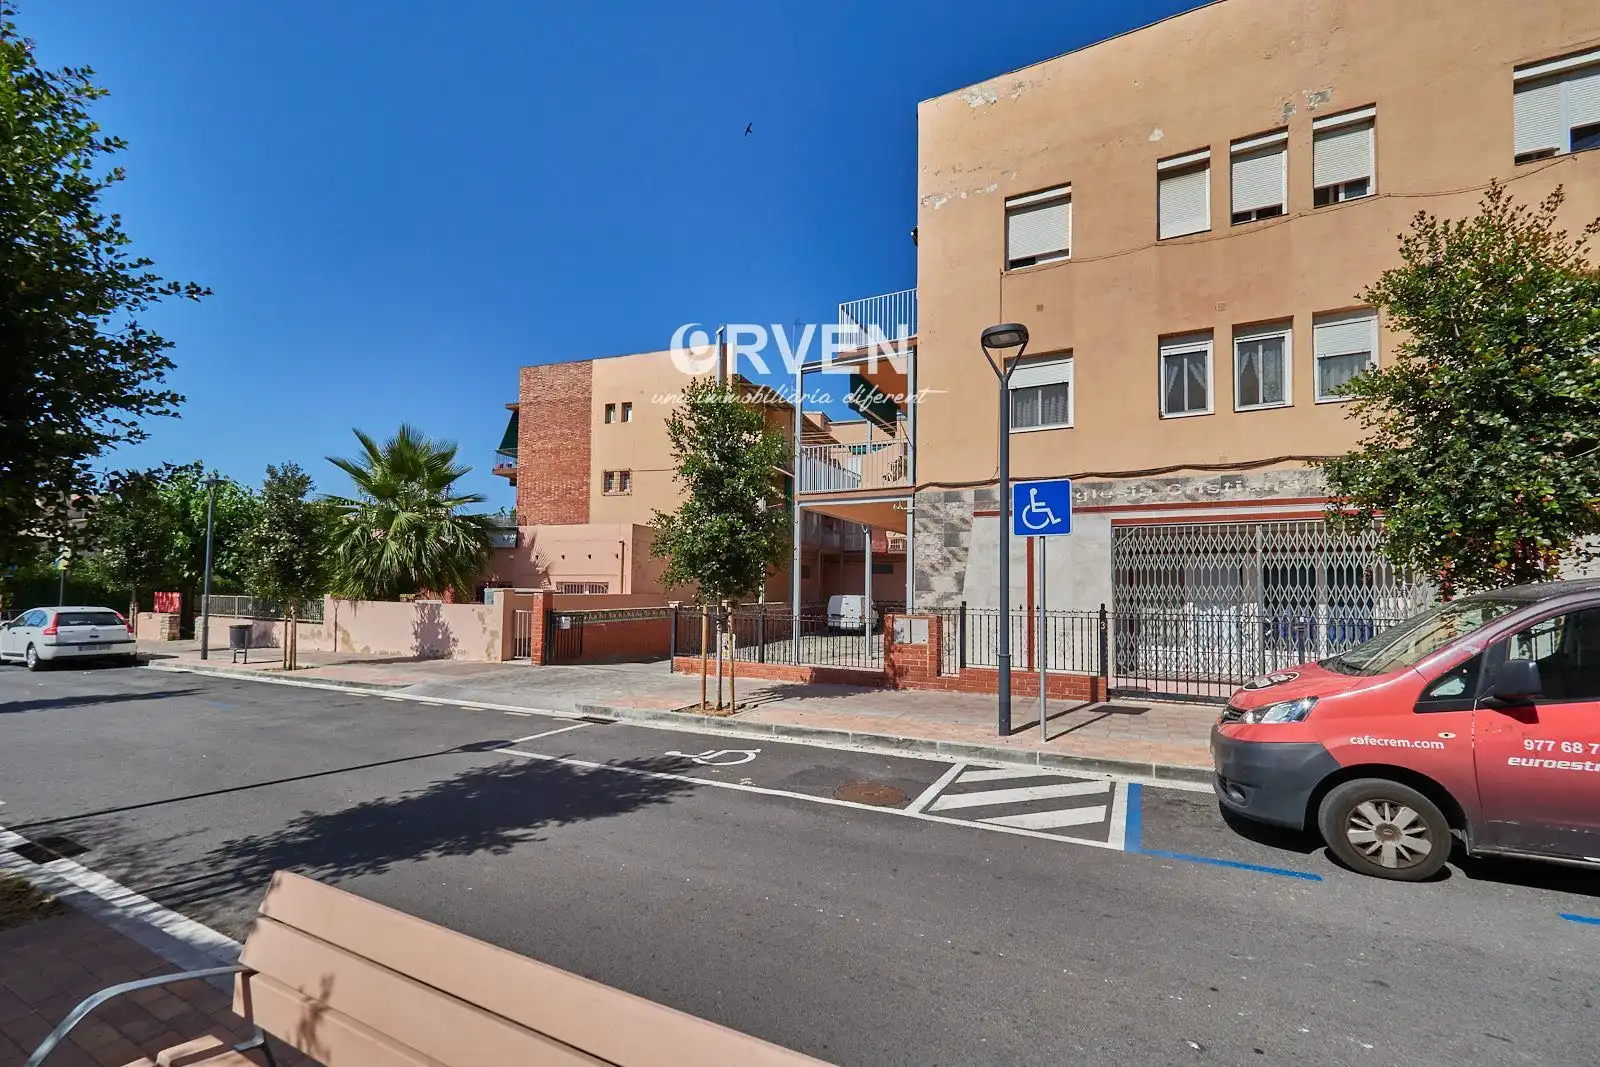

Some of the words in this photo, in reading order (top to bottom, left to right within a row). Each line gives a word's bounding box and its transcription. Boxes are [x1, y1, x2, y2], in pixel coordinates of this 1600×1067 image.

[1075, 485, 1155, 503] glesia
[1100, 621, 1106, 630] 3
[1350, 735, 1445, 750] cafecrem.com
[1523, 738, 1556, 752] 977
[1561, 741, 1583, 754] 68
